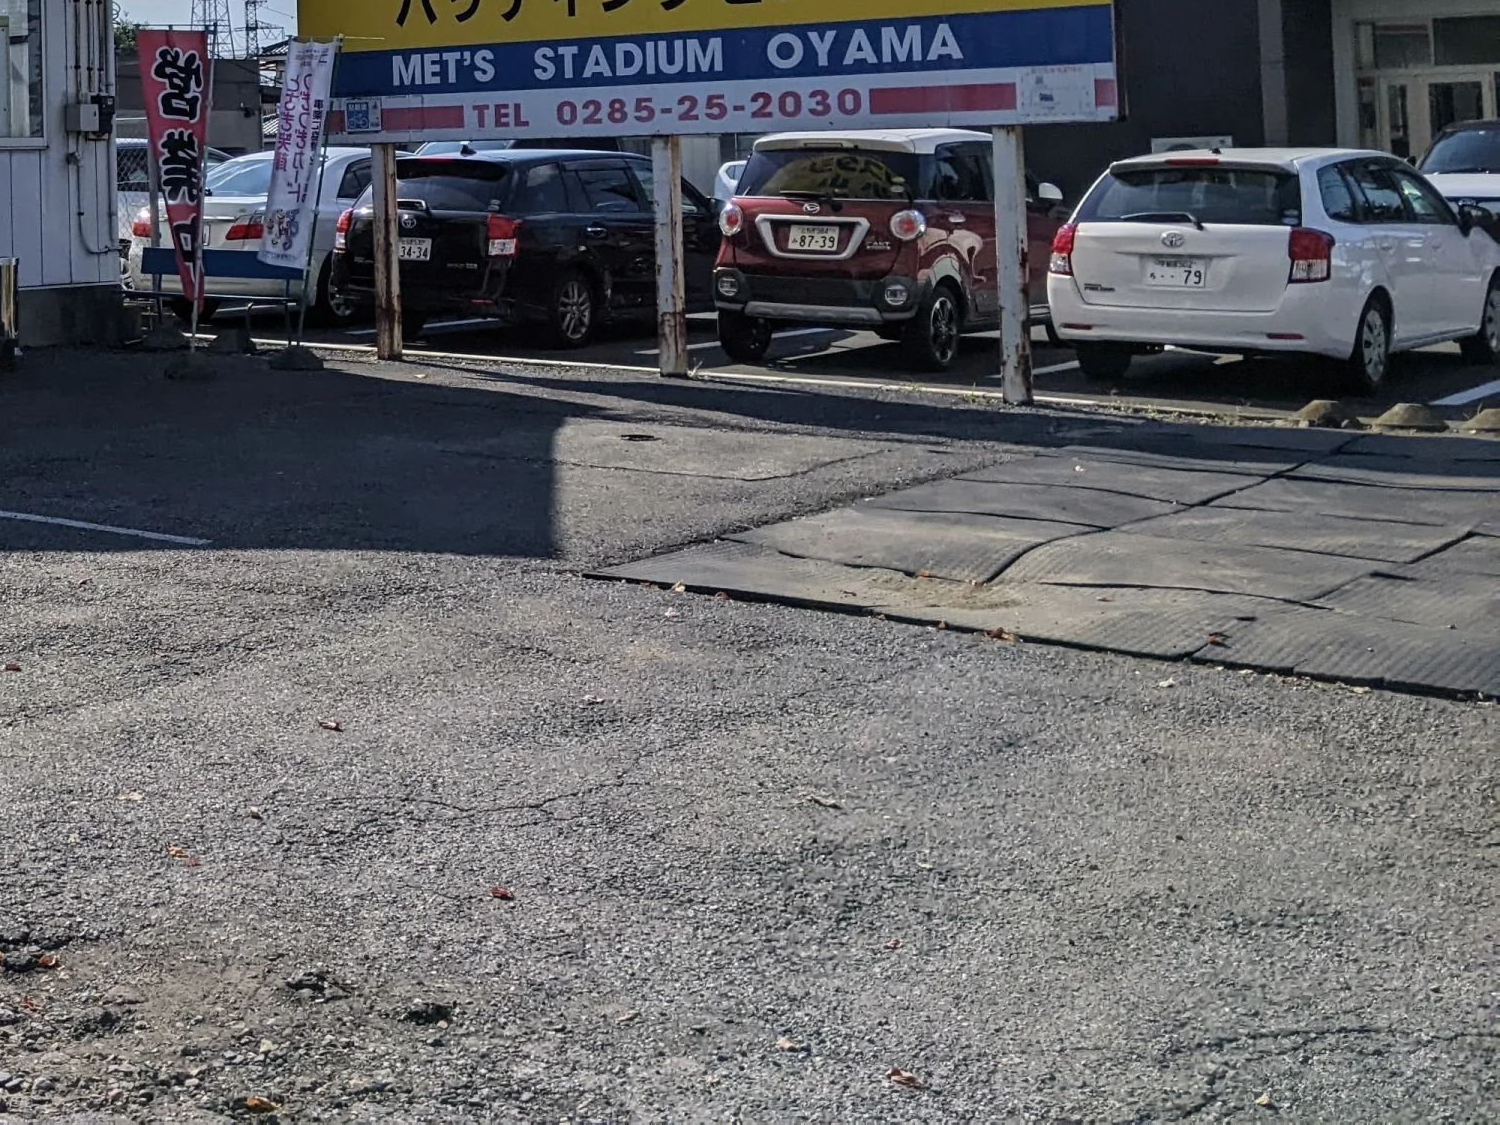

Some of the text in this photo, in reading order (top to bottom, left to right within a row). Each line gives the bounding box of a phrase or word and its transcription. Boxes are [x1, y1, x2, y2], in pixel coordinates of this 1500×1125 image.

[392, 23, 964, 87] MET'S STADIUM OYAMA
[473, 88, 862, 129] TEL 0285-25-2030
[400, 245, 429, 259] 34-34
[799, 235, 836, 249] 87-39
